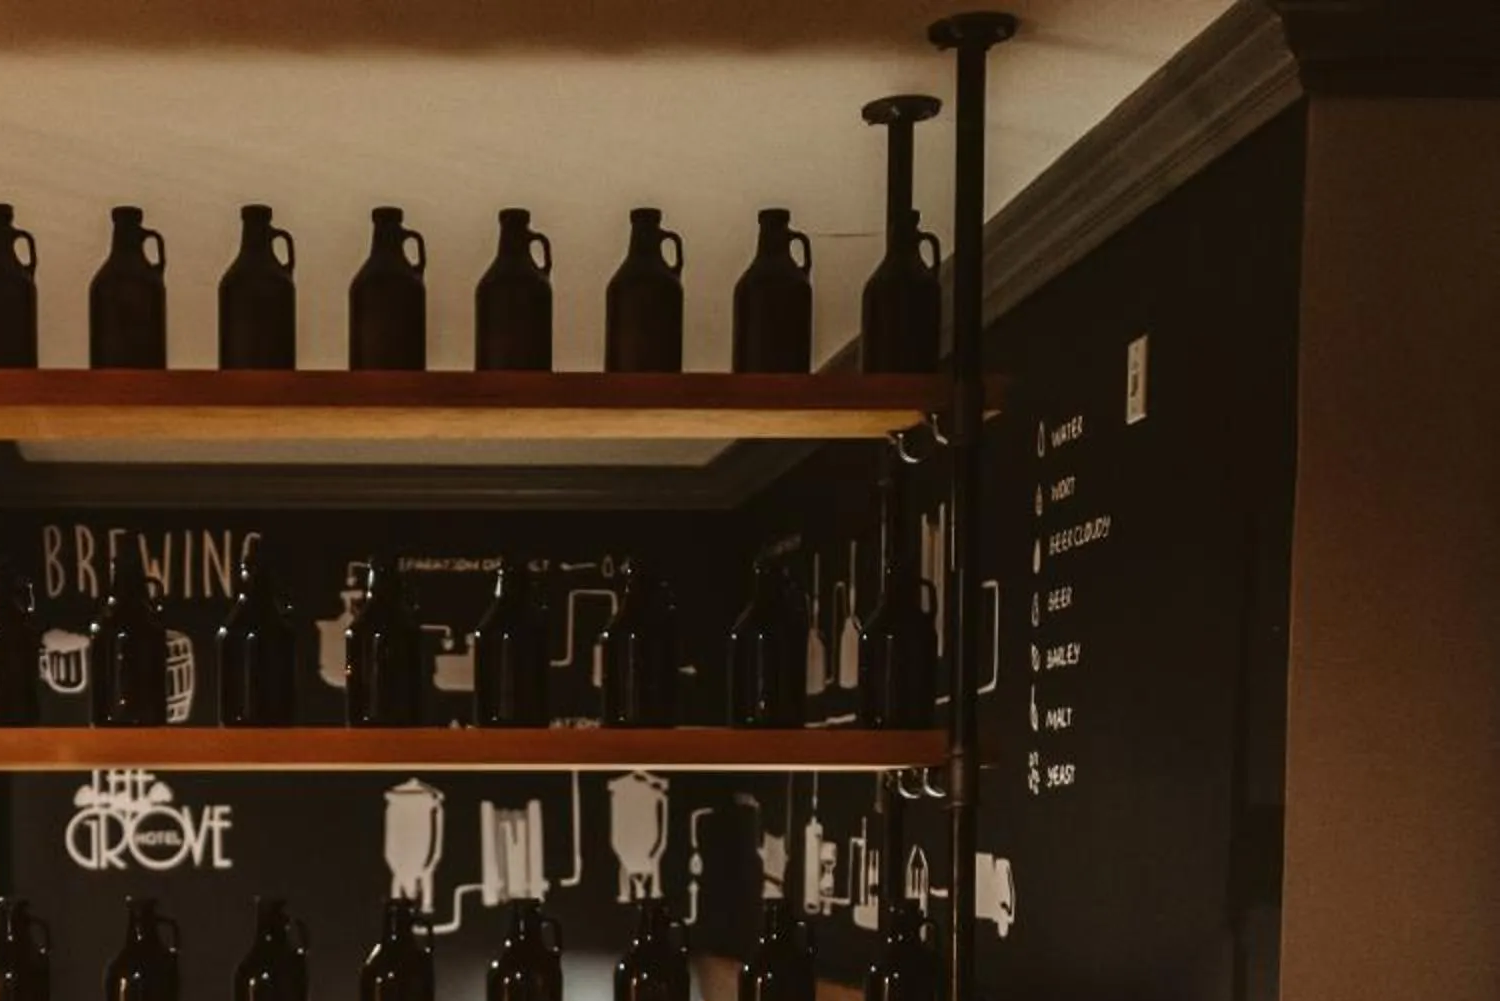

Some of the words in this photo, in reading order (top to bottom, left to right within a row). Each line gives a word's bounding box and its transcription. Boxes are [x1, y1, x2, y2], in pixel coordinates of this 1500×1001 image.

[1051, 415, 1083, 448] WATER
[1048, 585, 1073, 612] BEER
[1046, 707, 1073, 730] MALT
[1047, 764, 1076, 788] YEAST
[65, 804, 233, 870] GROVE
[136, 830, 184, 847] HOTEL
